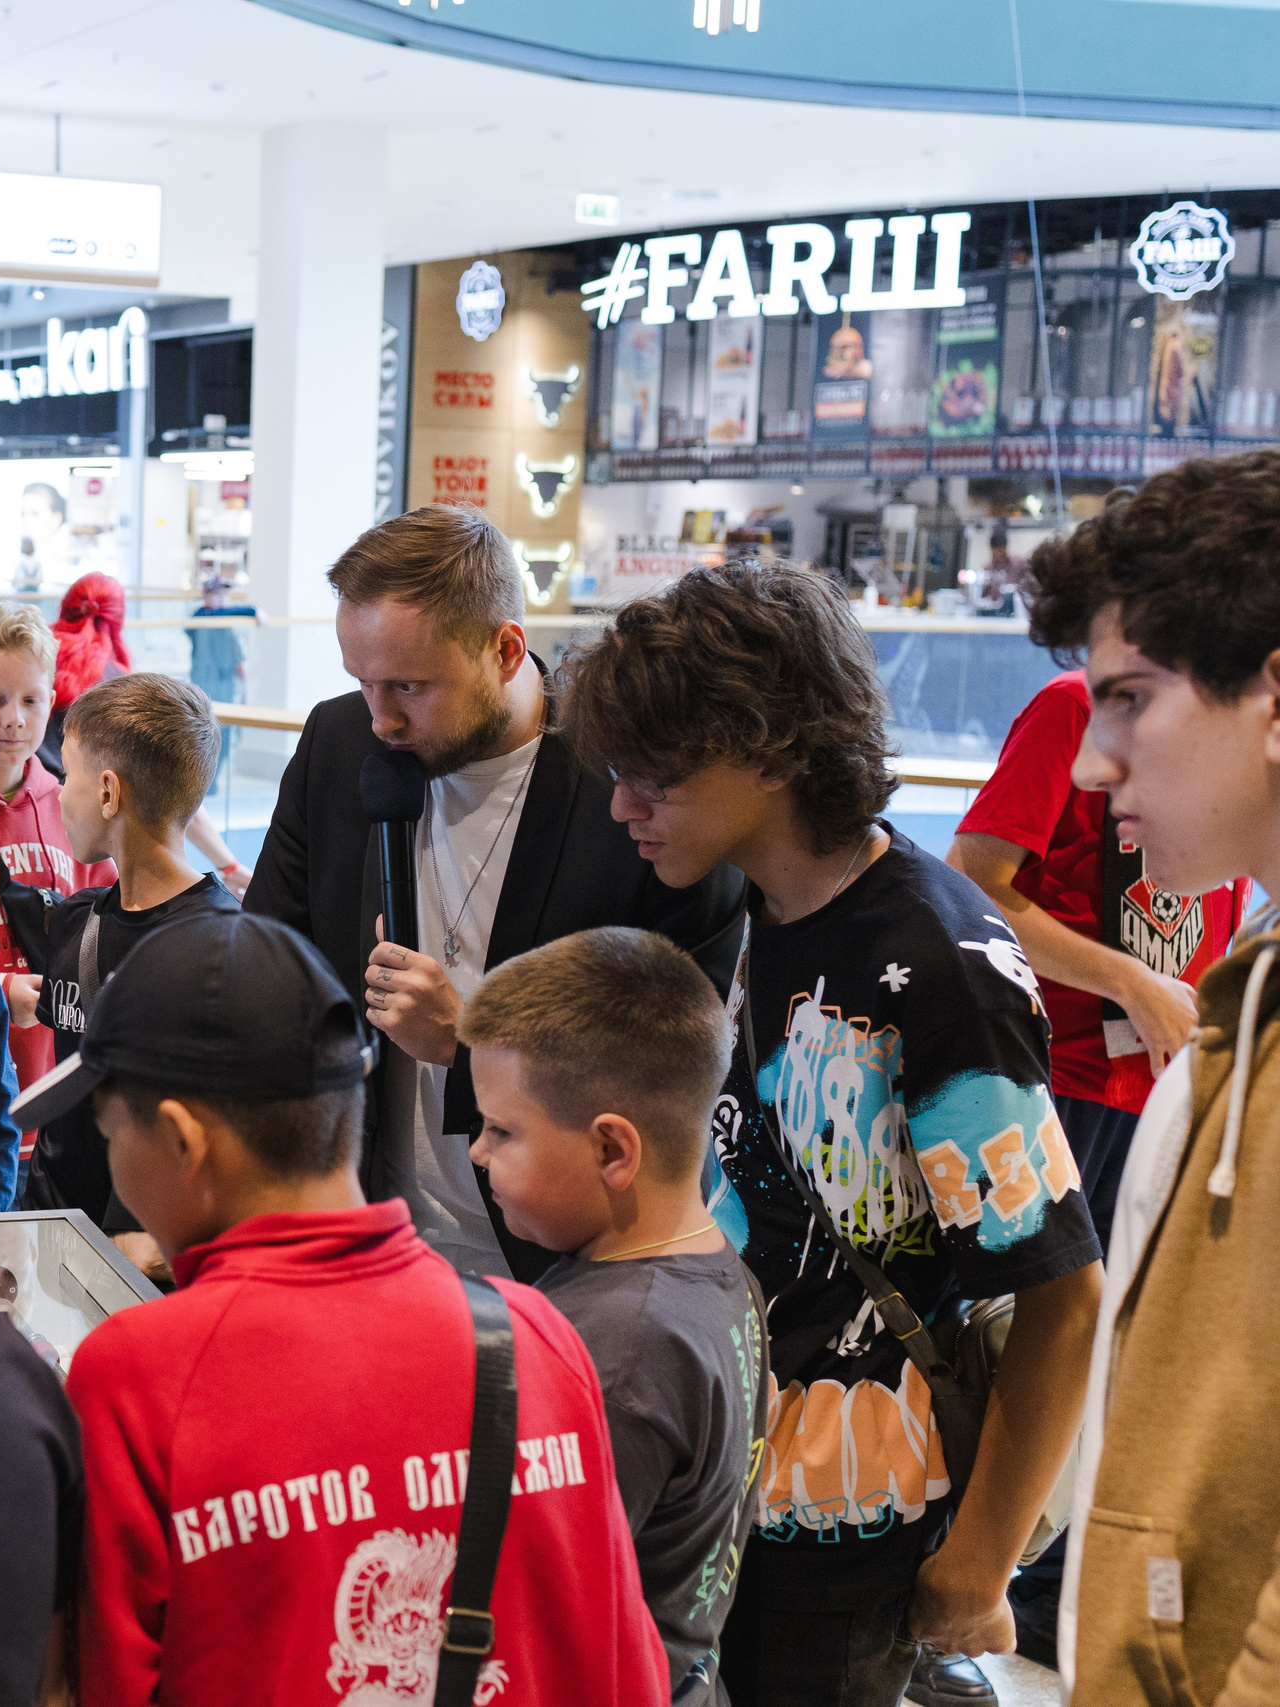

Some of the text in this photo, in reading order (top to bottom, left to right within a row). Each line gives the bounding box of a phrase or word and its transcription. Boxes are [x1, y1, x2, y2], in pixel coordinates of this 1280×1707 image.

[432, 456, 488, 470] ENJOY
[616, 534, 687, 551] BLAC
[171, 1463, 377, 1565] БАРОТОВ
